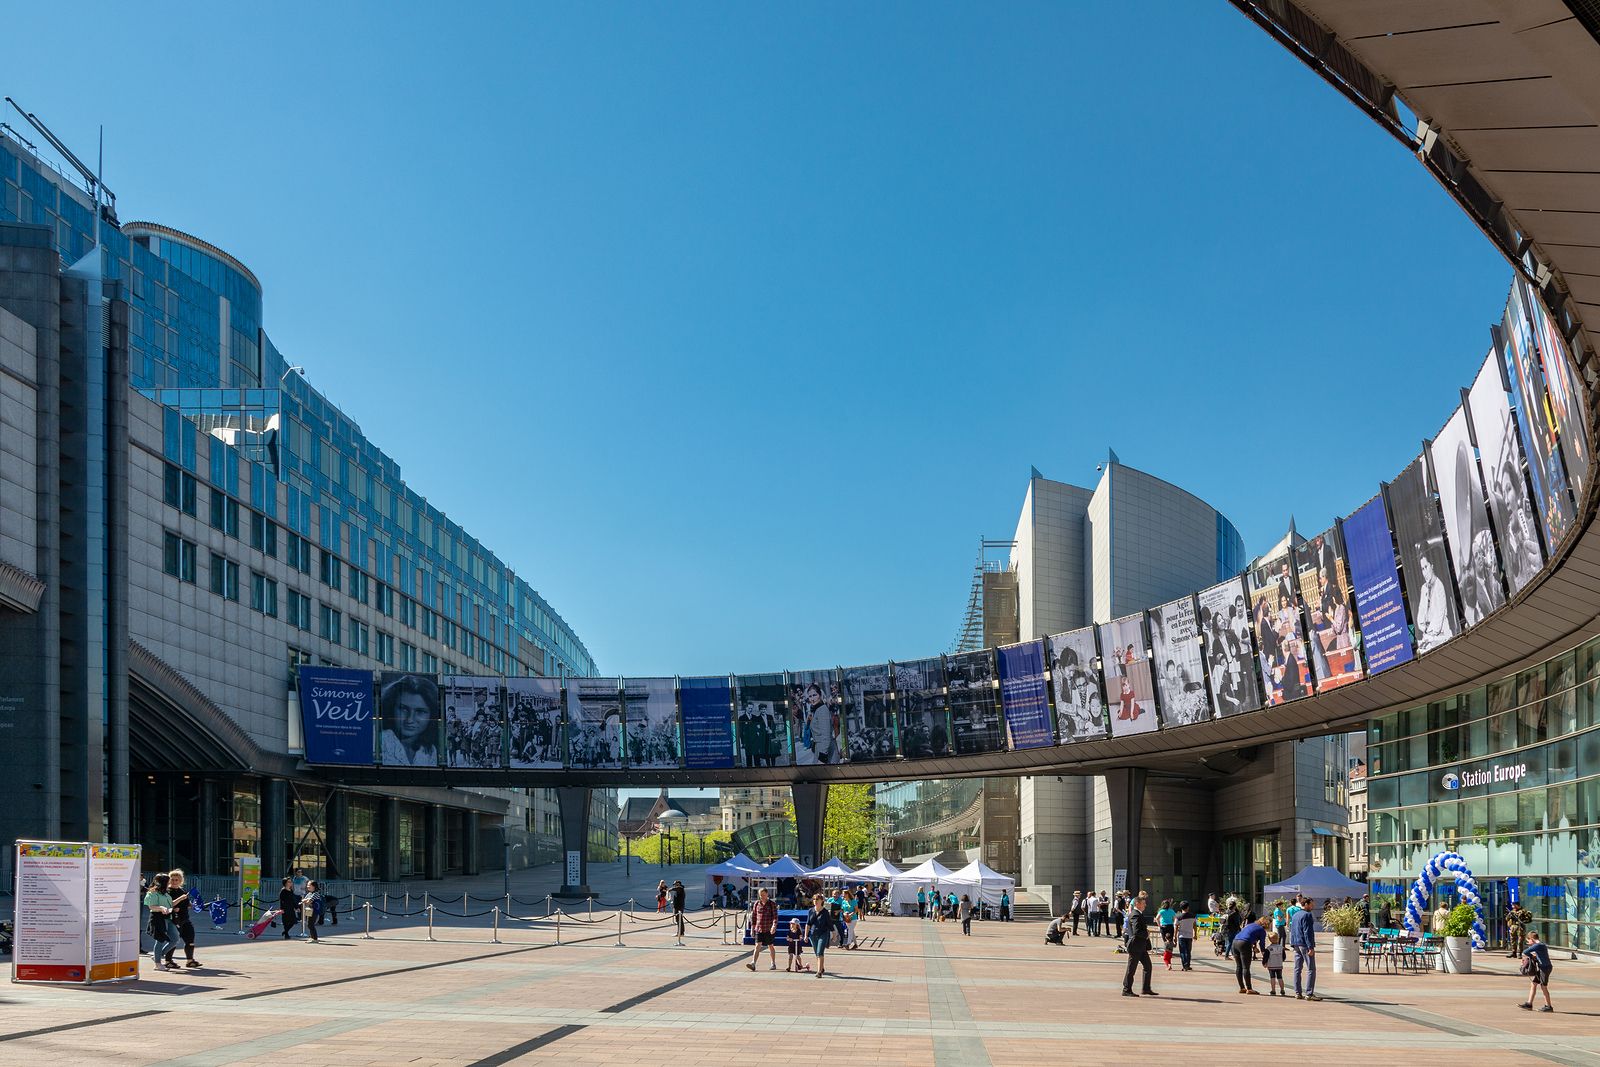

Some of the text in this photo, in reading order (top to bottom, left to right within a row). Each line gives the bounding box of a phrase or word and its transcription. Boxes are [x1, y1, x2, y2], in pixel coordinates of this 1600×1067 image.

[1177, 600, 1189, 611] Agir
[1166, 613, 1178, 624] pour
[1171, 622, 1178, 630] en
[1179, 626, 1192, 635] avec
[1171, 634, 1190, 645] Simone
[311, 686, 366, 700] Simone
[312, 699, 370, 722] Veil
[1461, 763, 1526, 788] Station Europe
[1372, 882, 1405, 895] Welcome
